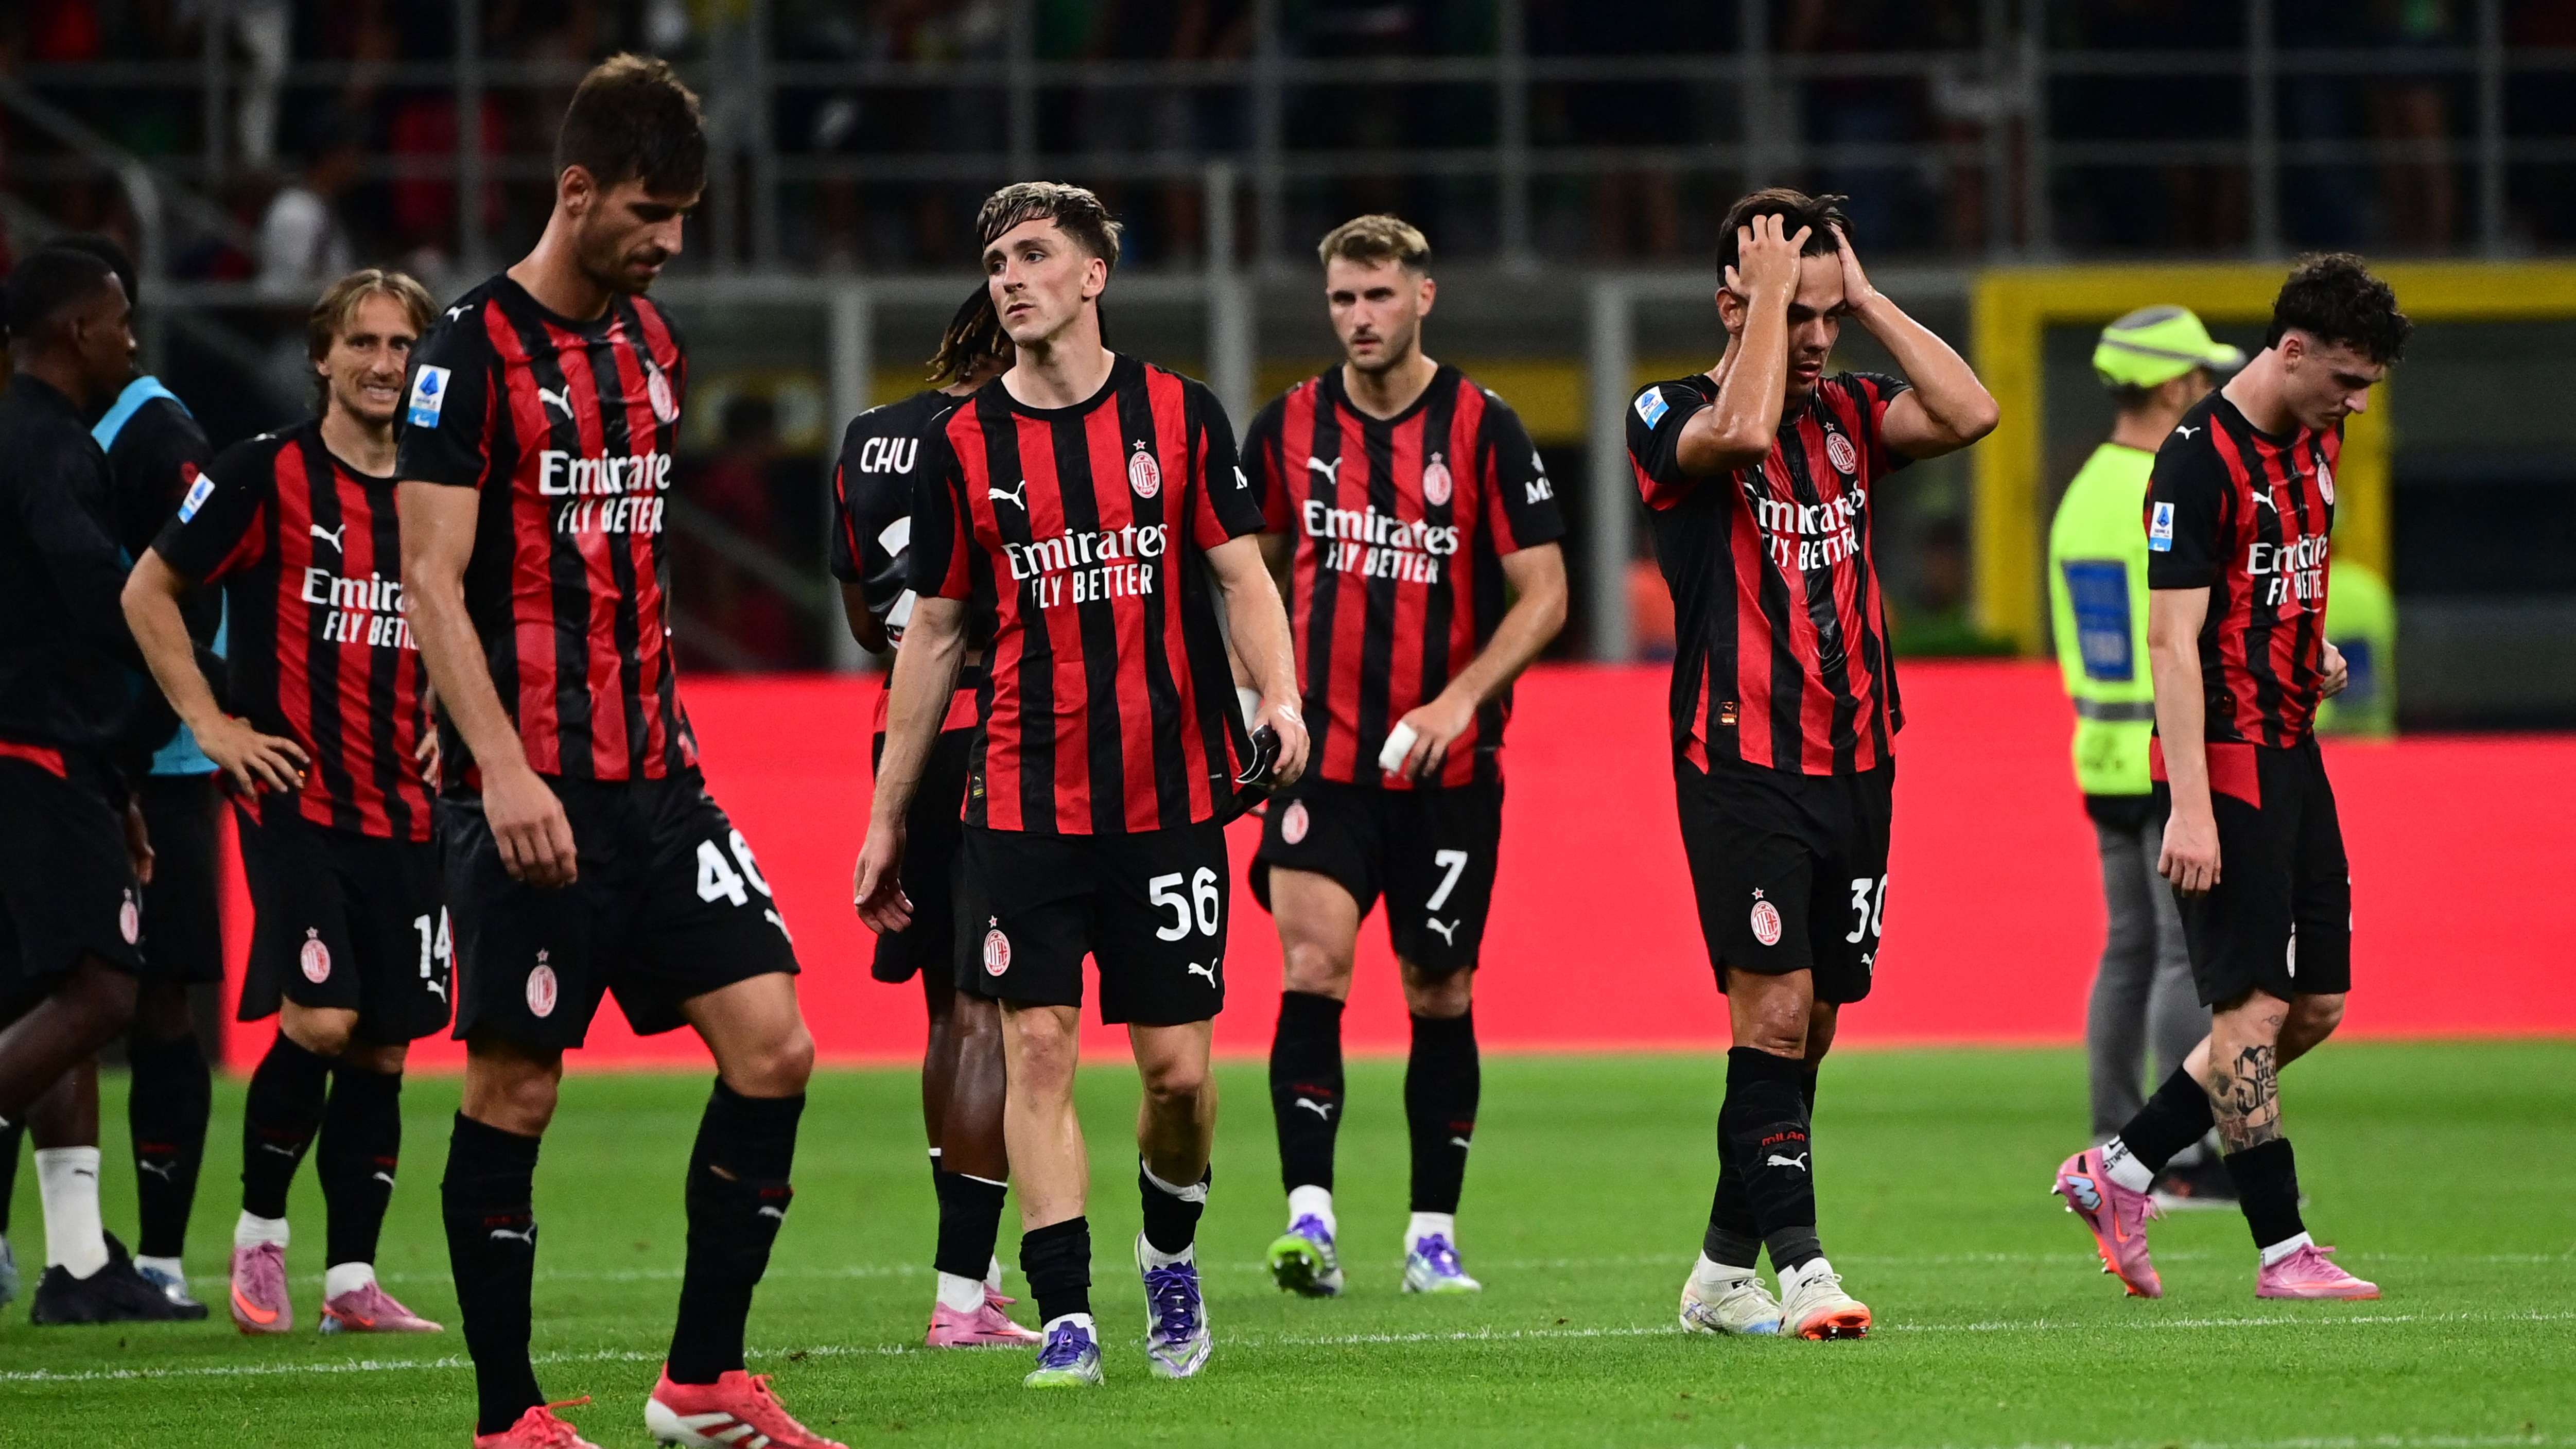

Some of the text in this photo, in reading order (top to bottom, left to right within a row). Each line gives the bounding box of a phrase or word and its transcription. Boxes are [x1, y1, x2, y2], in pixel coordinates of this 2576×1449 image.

[538, 448, 671, 495] Emirate
[860, 437, 918, 474] CHU
[1302, 499, 1459, 555] Emirates
[1001, 522, 1168, 581] Emirates
[1362, 547, 1439, 584] BETTER
[302, 567, 406, 613] Emira
[1032, 563, 1153, 610] FLY BETTER
[2294, 569, 2324, 599] BETTE
[323, 610, 365, 643] FLY
[1425, 849, 1468, 911] 7
[1149, 866, 1219, 942] 56
[413, 904, 451, 979] 14
